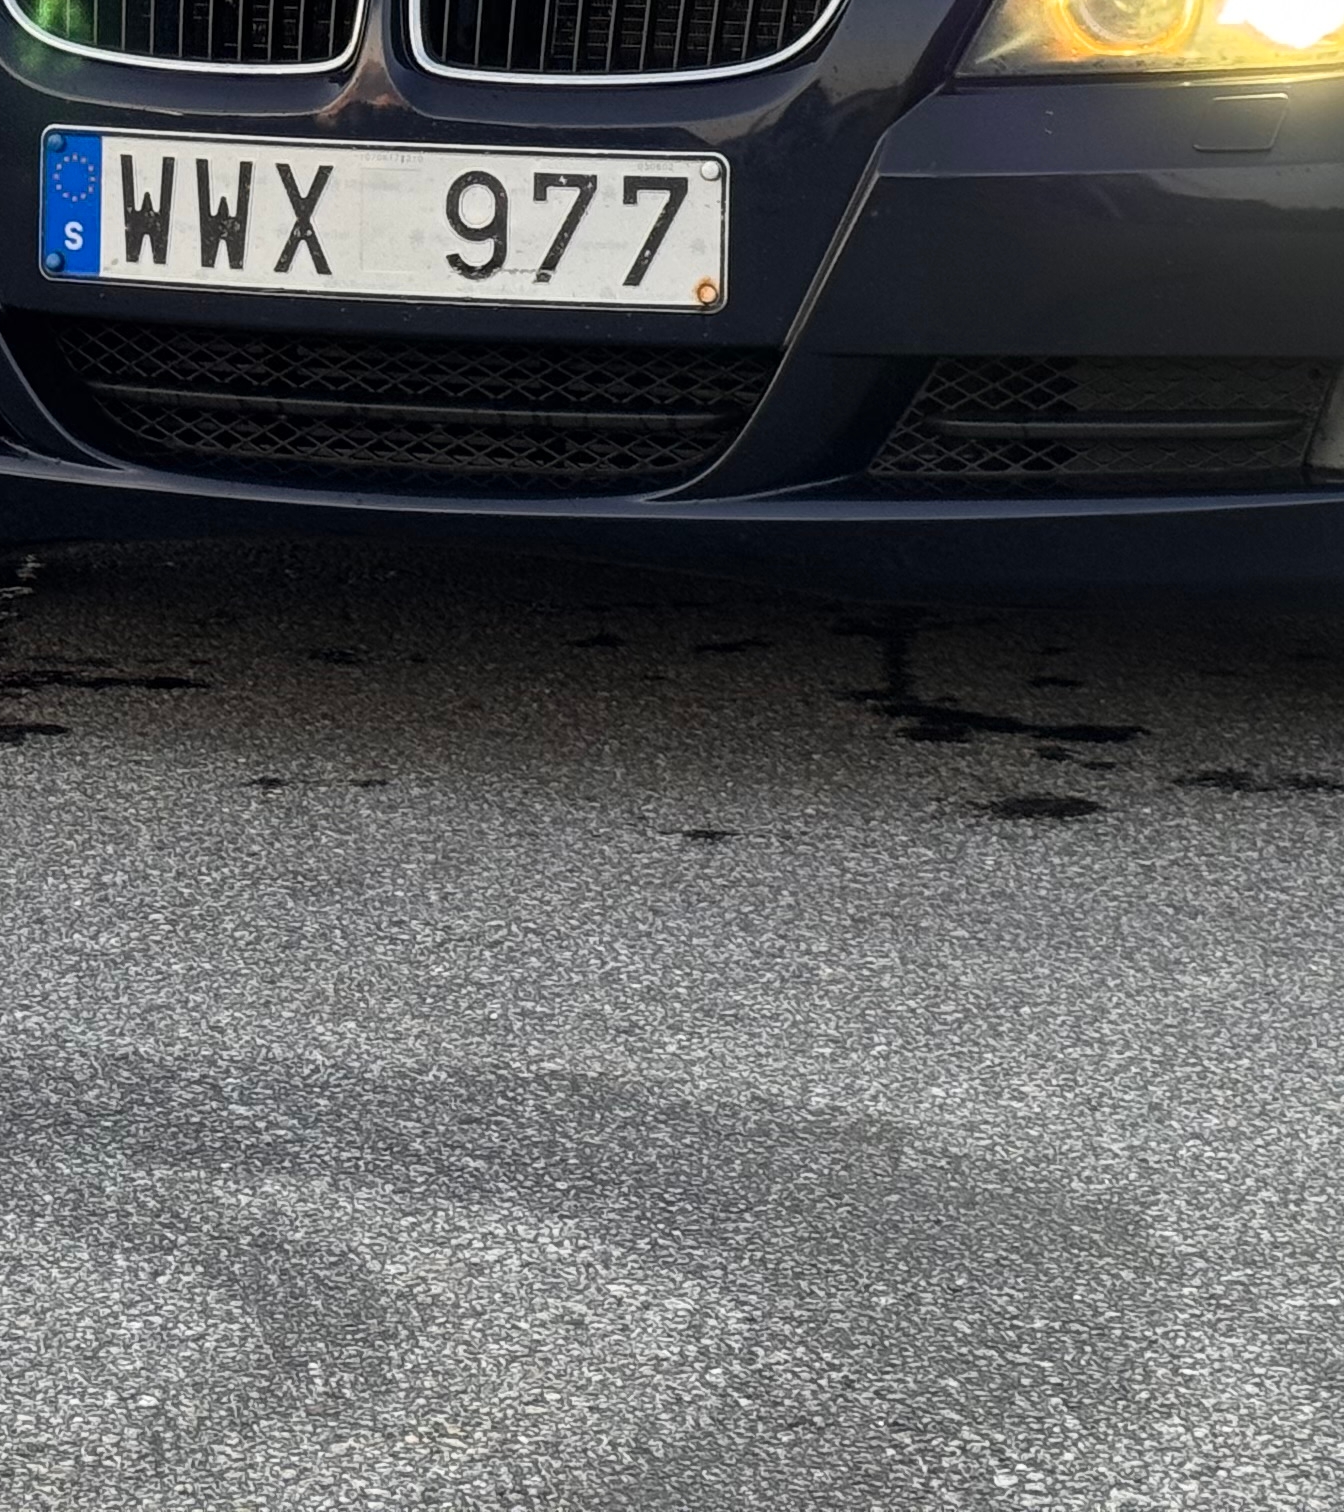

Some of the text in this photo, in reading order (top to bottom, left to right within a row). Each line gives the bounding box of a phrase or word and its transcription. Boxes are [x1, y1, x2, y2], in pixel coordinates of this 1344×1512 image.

[64, 220, 84, 251] S
[119, 153, 690, 287] WWX 977
